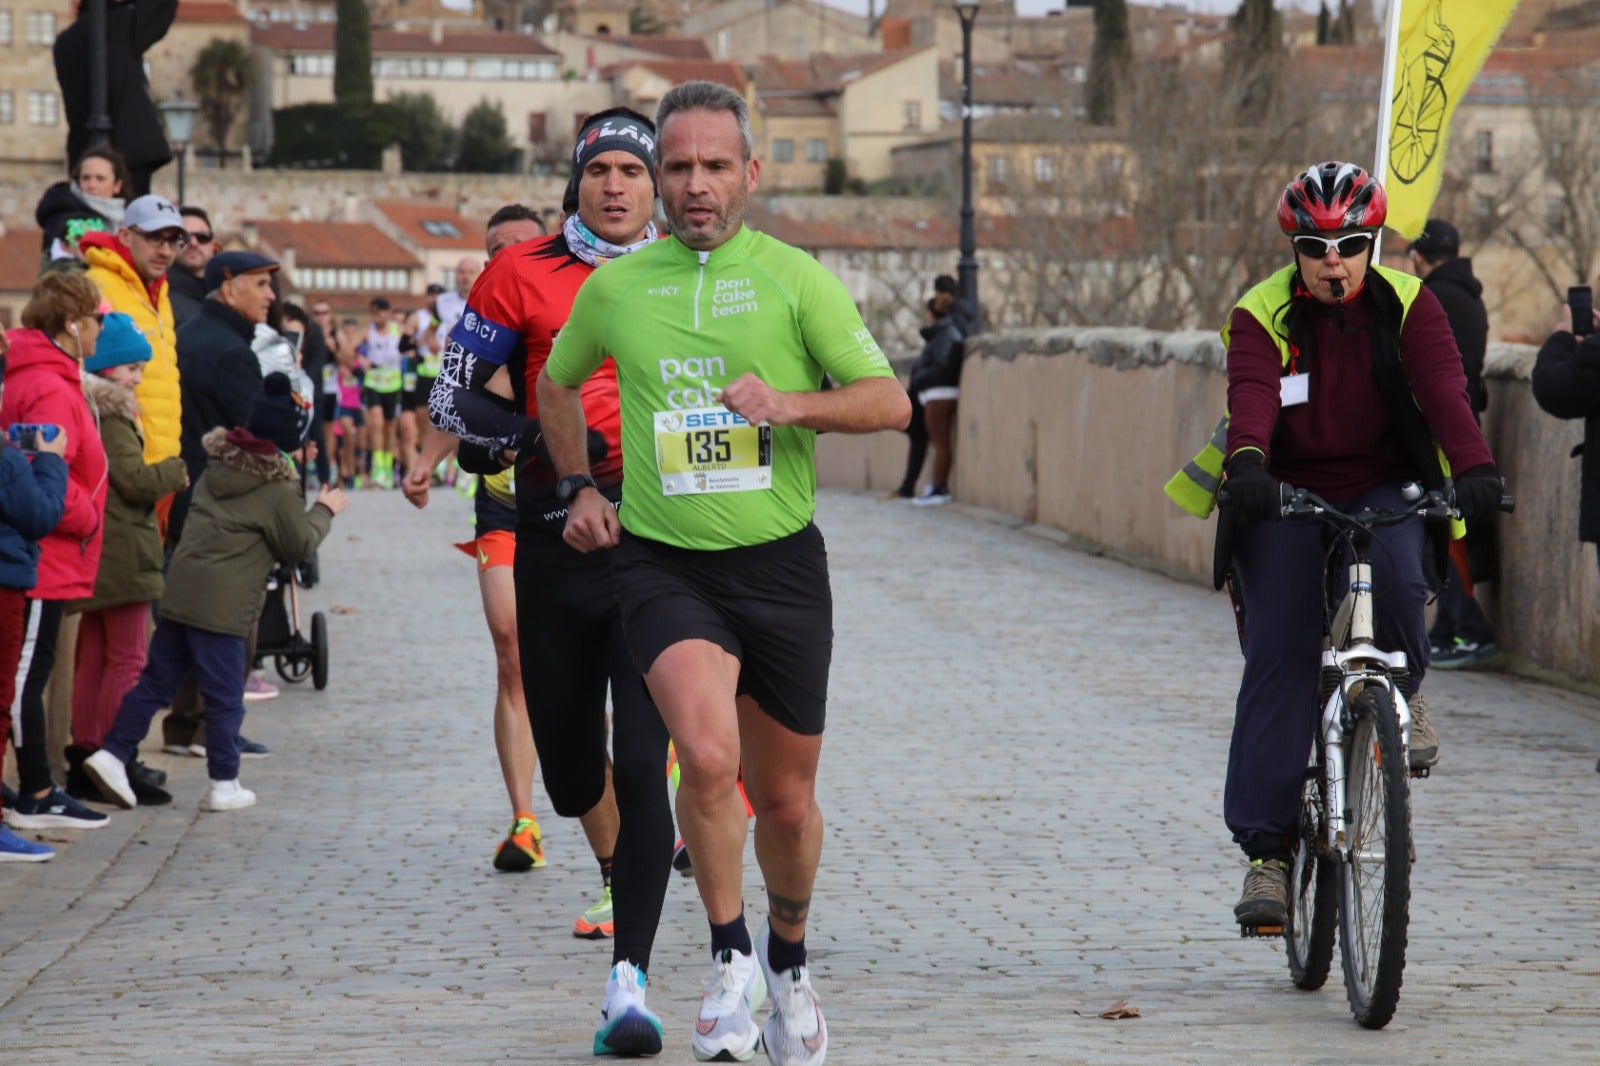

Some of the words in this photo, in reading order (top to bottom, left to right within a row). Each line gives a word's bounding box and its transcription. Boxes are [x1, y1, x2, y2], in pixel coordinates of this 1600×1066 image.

[715, 278, 750, 292] pan
[712, 287, 756, 303] cake
[712, 301, 758, 318] team
[659, 356, 726, 385] pan
[685, 429, 732, 464] 135
